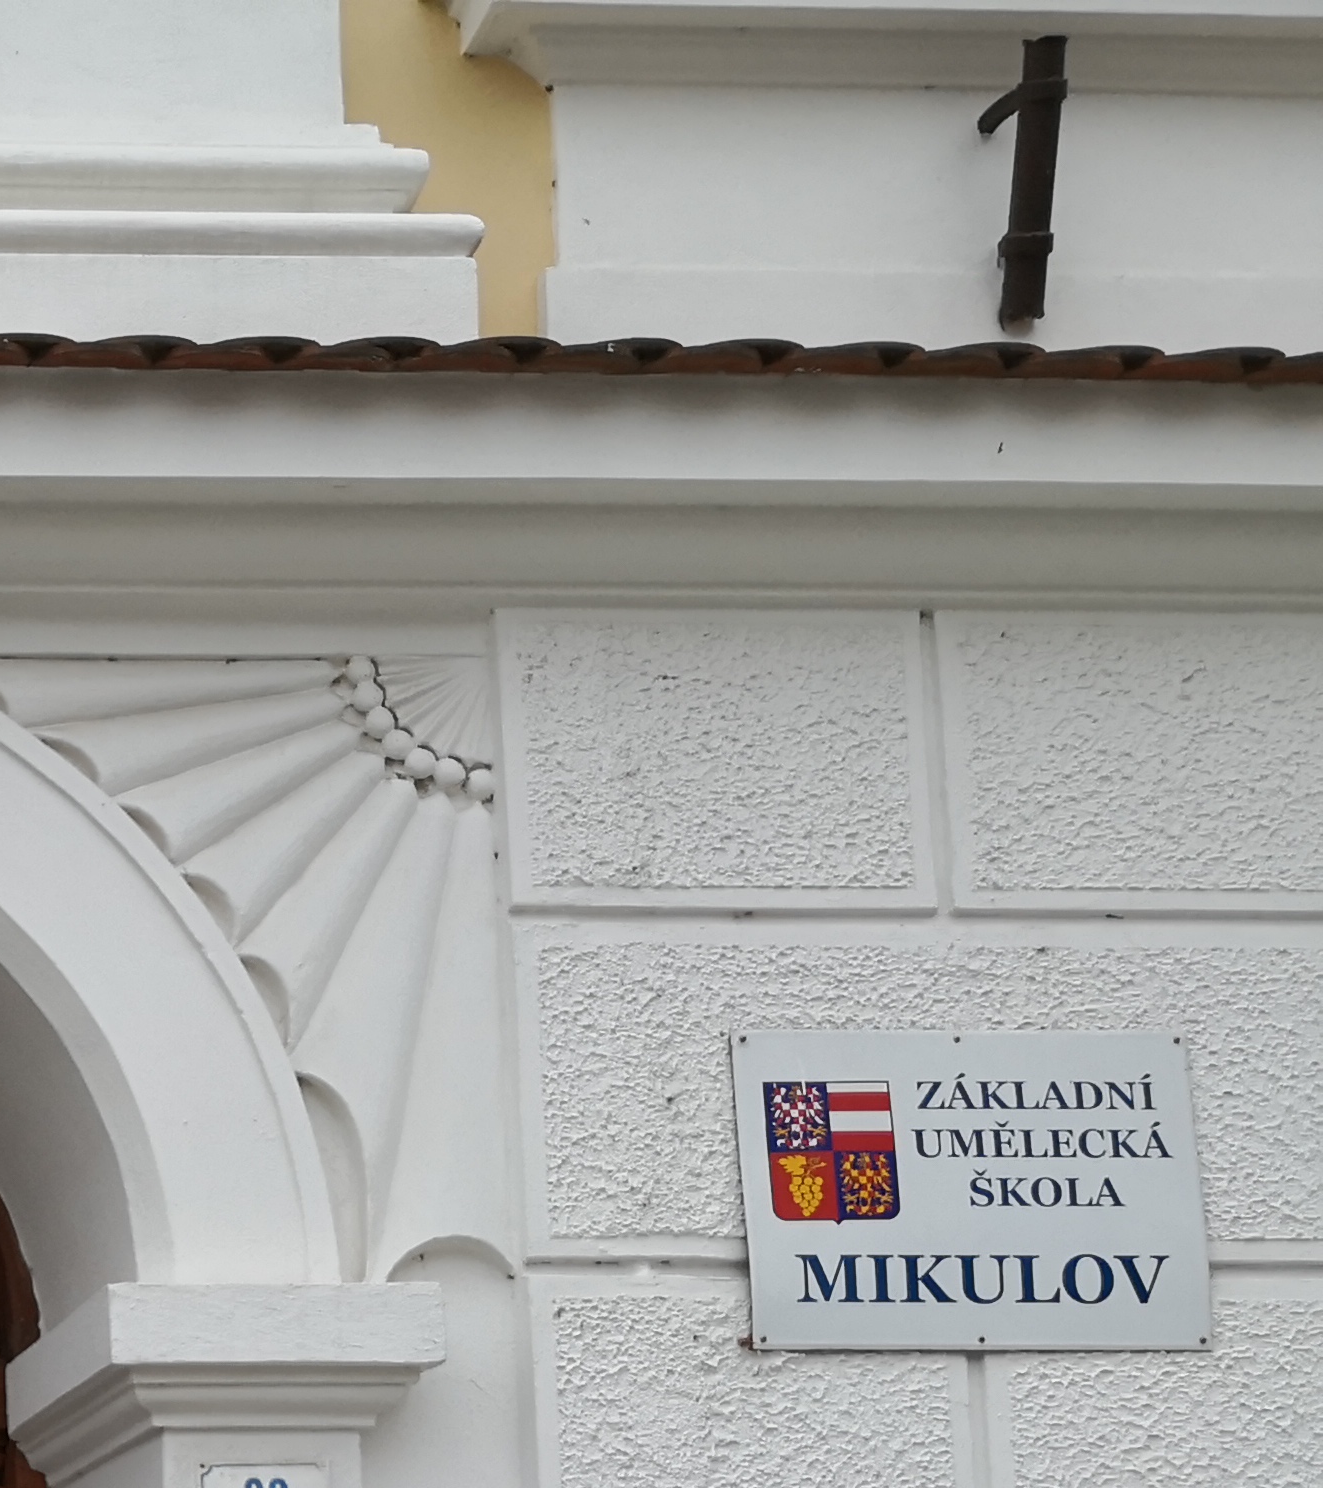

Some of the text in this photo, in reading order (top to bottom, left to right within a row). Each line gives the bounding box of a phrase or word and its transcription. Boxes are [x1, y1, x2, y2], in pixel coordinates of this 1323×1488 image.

[916, 1073, 1156, 1110] ZÁKLADNÍ
[912, 1122, 1173, 1159] UMĚLECKÁ
[970, 1169, 1125, 1208] ŠKOLA
[795, 1254, 1169, 1305] MIKULOV
